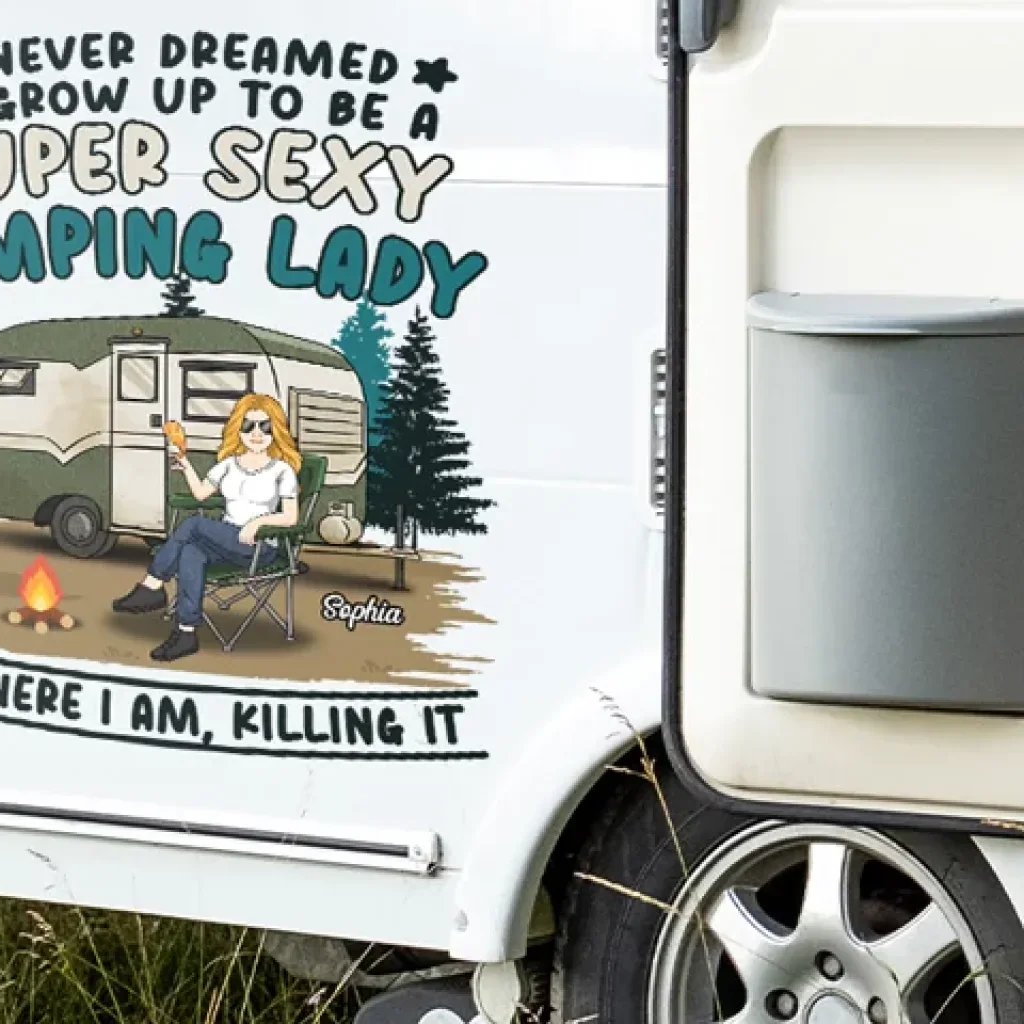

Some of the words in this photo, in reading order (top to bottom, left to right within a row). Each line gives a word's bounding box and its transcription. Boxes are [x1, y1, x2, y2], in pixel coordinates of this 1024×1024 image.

[160, 31, 398, 84] DREAMED
[153, 77, 216, 115] UP
[239, 79, 303, 120] TO
[329, 91, 387, 130] BE
[409, 103, 439, 141] A
[203, 126, 454, 223] SEXY
[267, 215, 488, 319] LADY
[320, 592, 405, 631] Sophia
[100, 689, 111, 726] I
[130, 694, 214, 746] AM,
[232, 701, 404, 746] KILLING
[422, 704, 466, 744] IT
